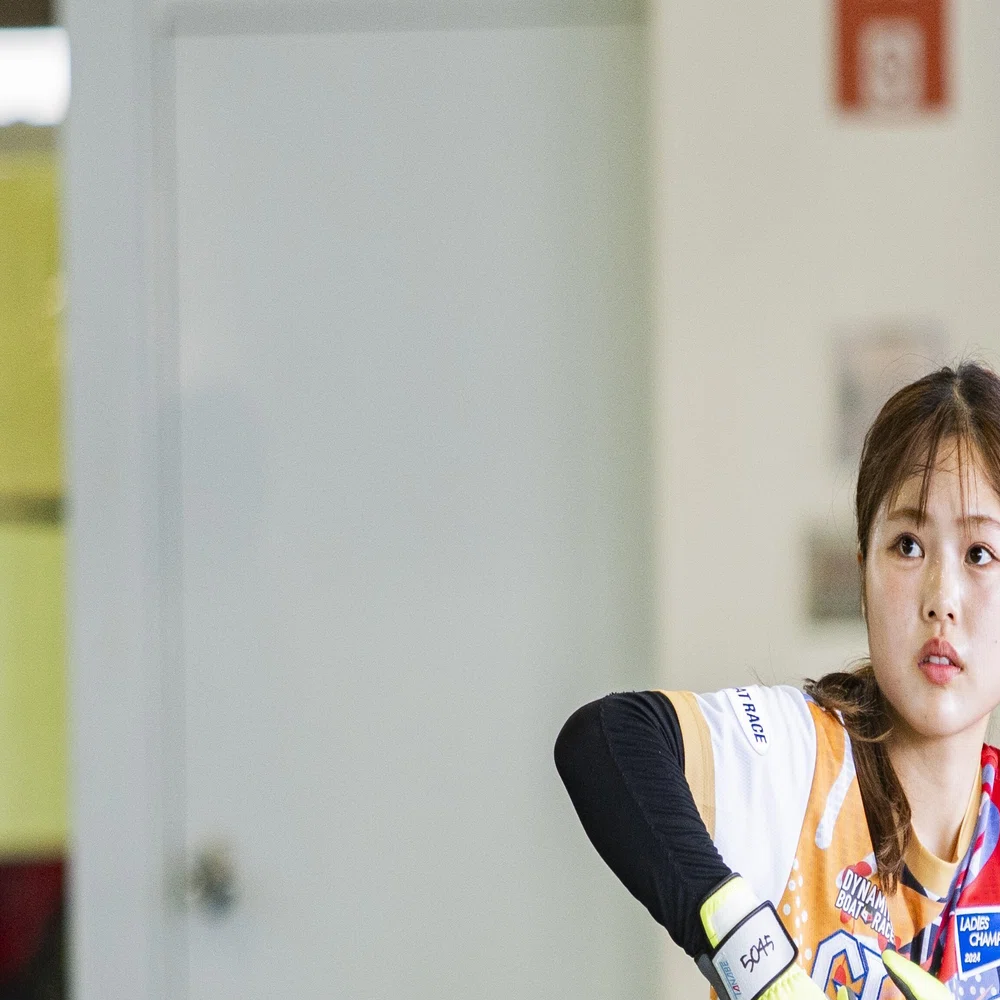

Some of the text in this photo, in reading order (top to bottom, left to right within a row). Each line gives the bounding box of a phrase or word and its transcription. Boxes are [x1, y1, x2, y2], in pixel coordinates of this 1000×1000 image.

[742, 703, 767, 743] RACE
[835, 889, 865, 920] BOAT
[960, 915, 991, 932] LADIES
[740, 934, 775, 973] 5045
[964, 952, 981, 964] 2024
